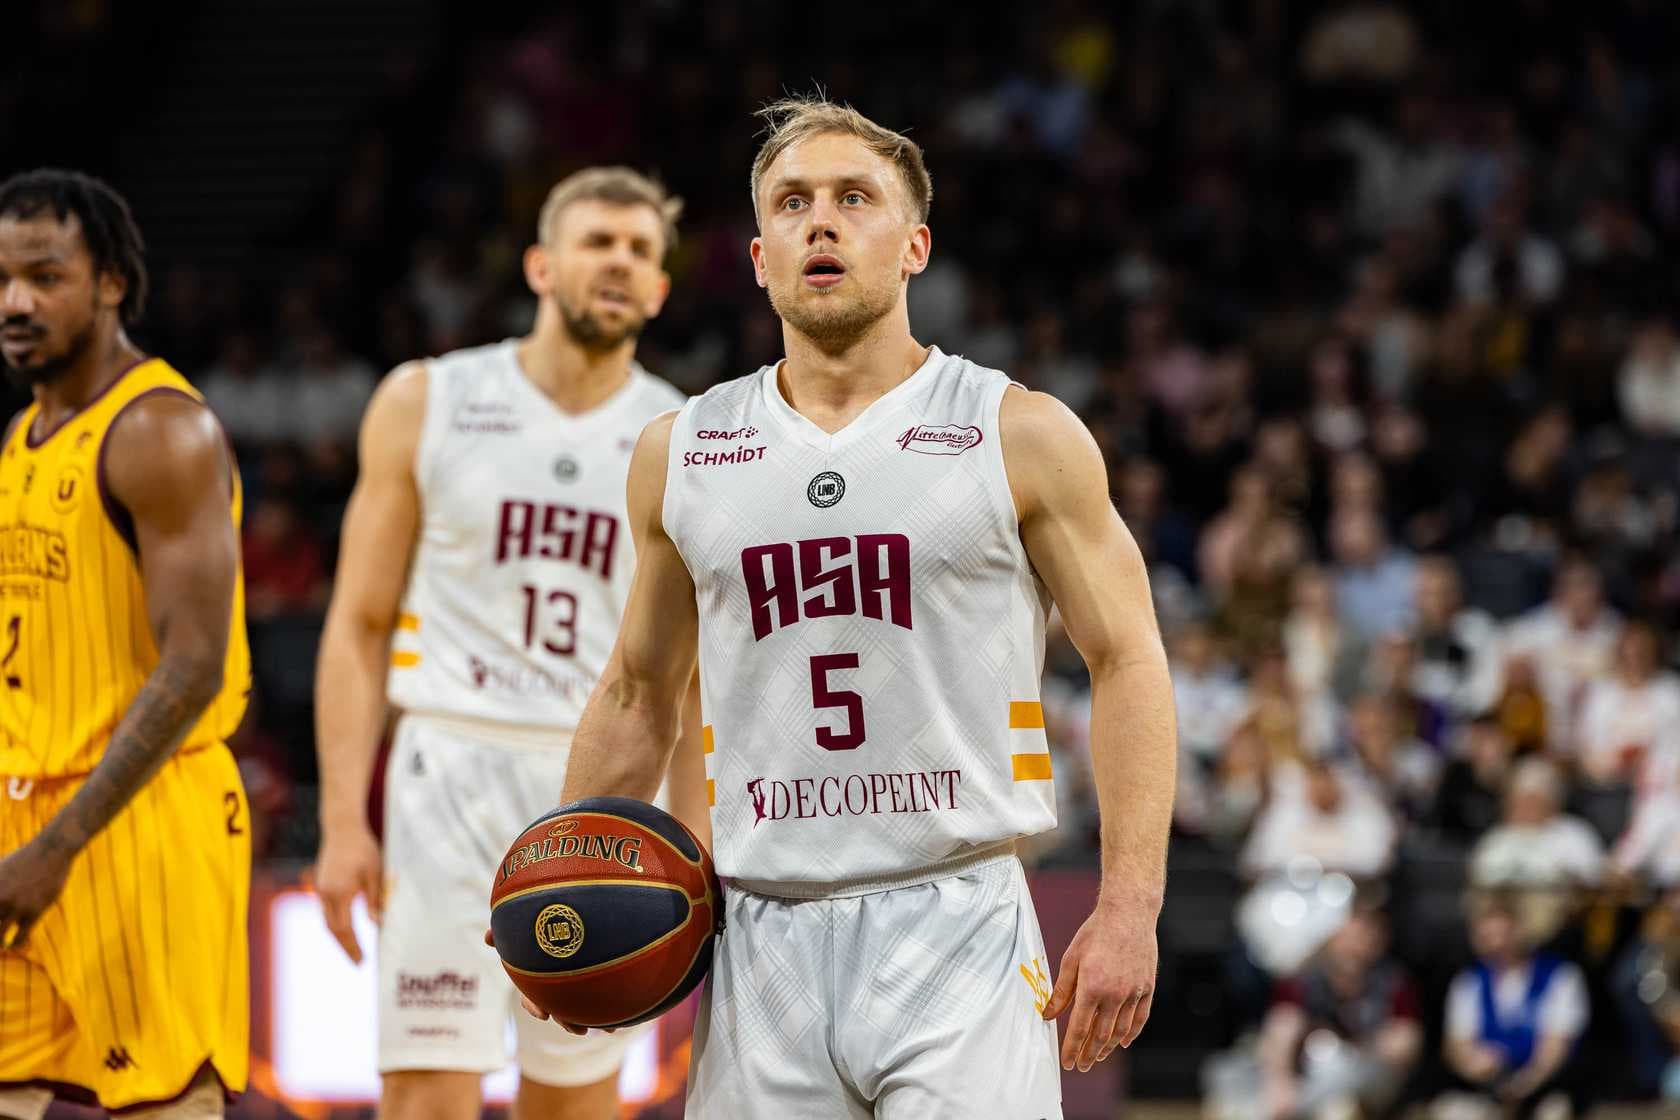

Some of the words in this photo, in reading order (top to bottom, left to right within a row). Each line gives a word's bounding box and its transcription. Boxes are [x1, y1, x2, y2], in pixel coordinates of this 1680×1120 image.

[697, 428, 746, 441] CRAFT
[817, 483, 836, 497] LNB
[496, 500, 620, 580] ASA
[520, 581, 578, 658] 13
[741, 534, 913, 642] ASA
[809, 652, 866, 751] 5
[224, 791, 244, 838] 2
[768, 769, 961, 821] DECOPEINT
